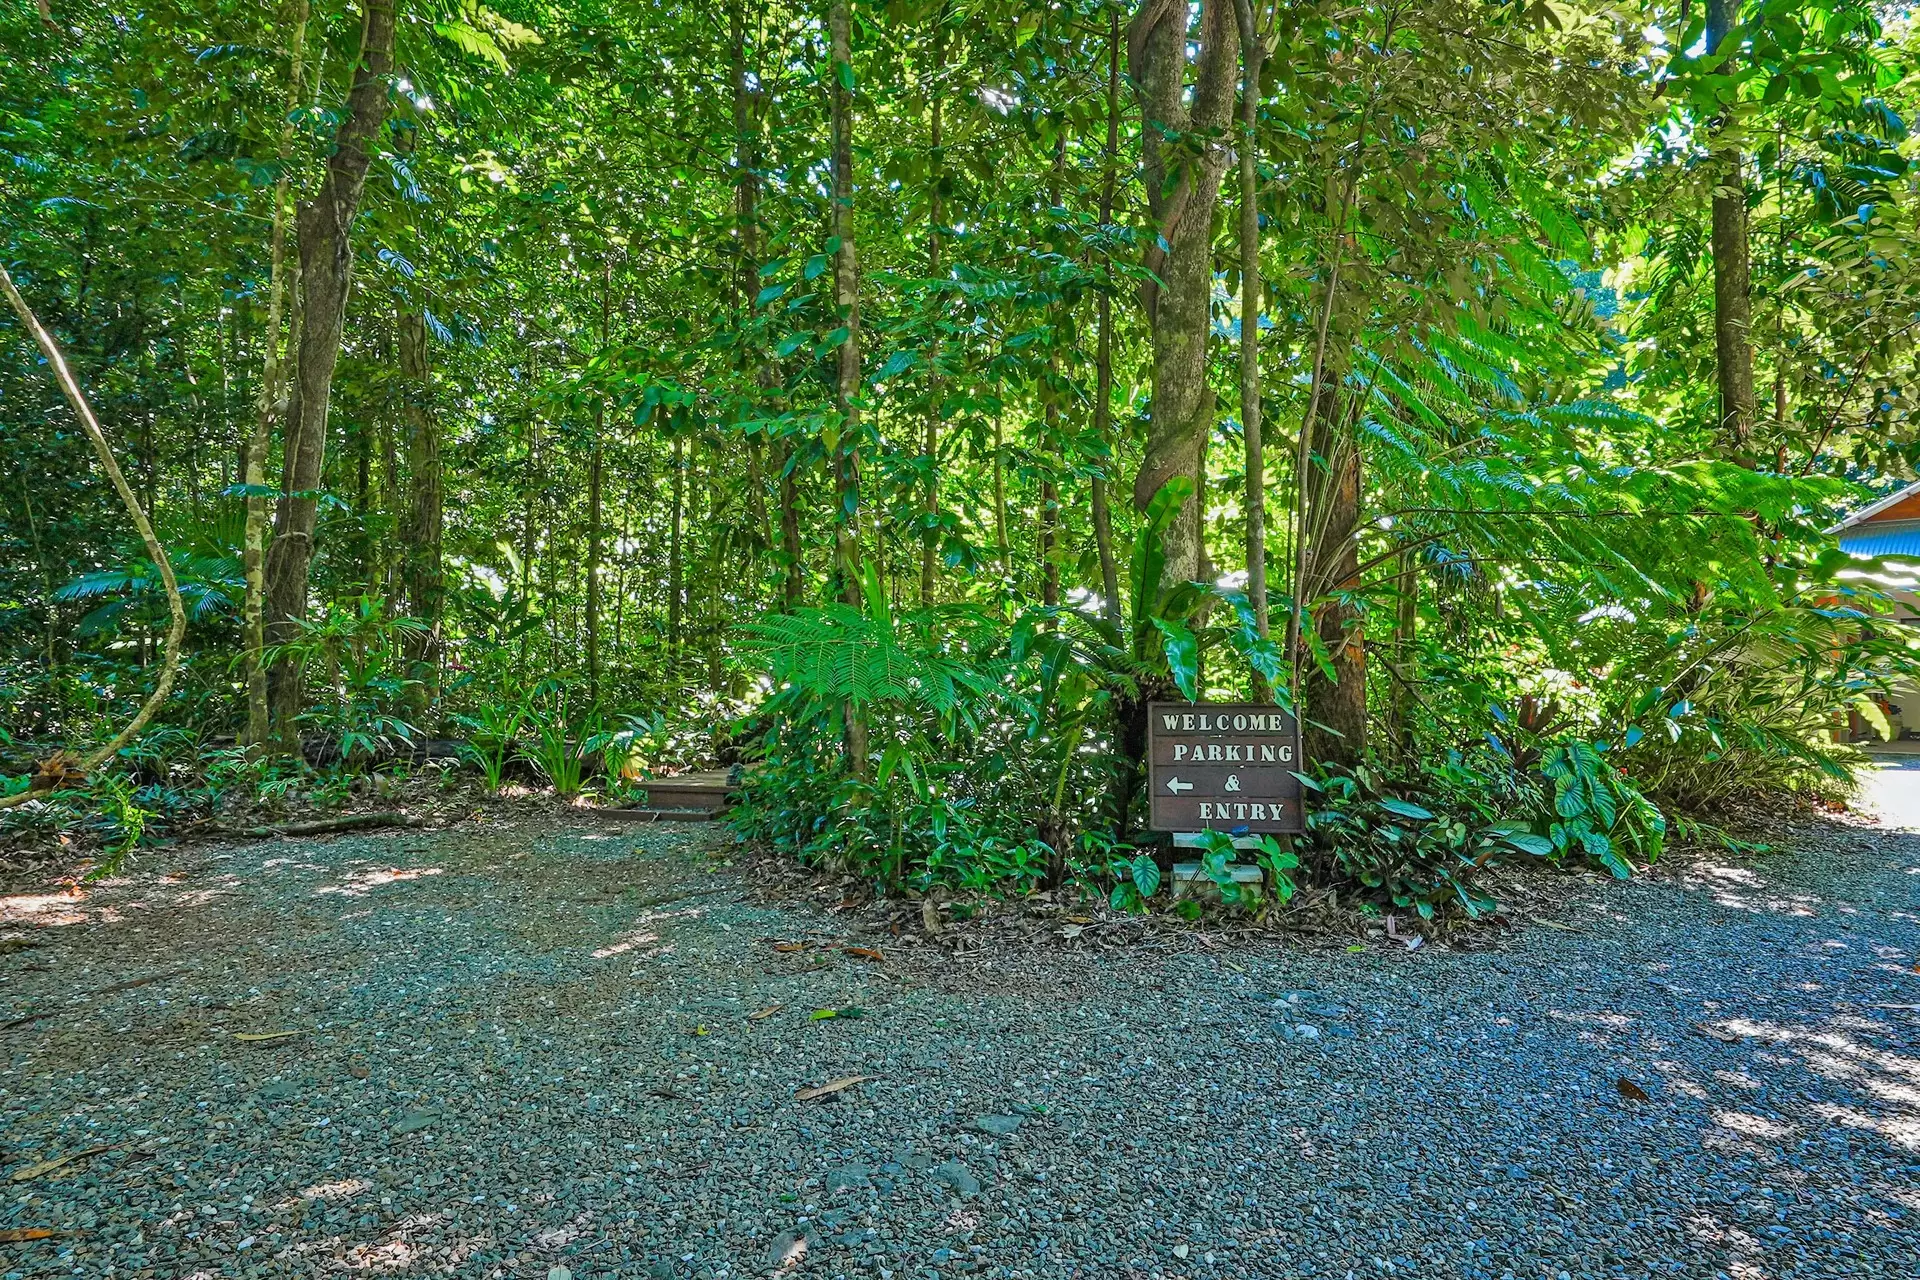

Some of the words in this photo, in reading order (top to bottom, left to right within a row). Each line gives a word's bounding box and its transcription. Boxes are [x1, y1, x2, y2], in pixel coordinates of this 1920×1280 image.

[1162, 714, 1282, 731] WELCOME
[1173, 744, 1293, 762] PARKING
[1224, 774, 1241, 792] &
[1199, 802, 1284, 821] ENTRY
